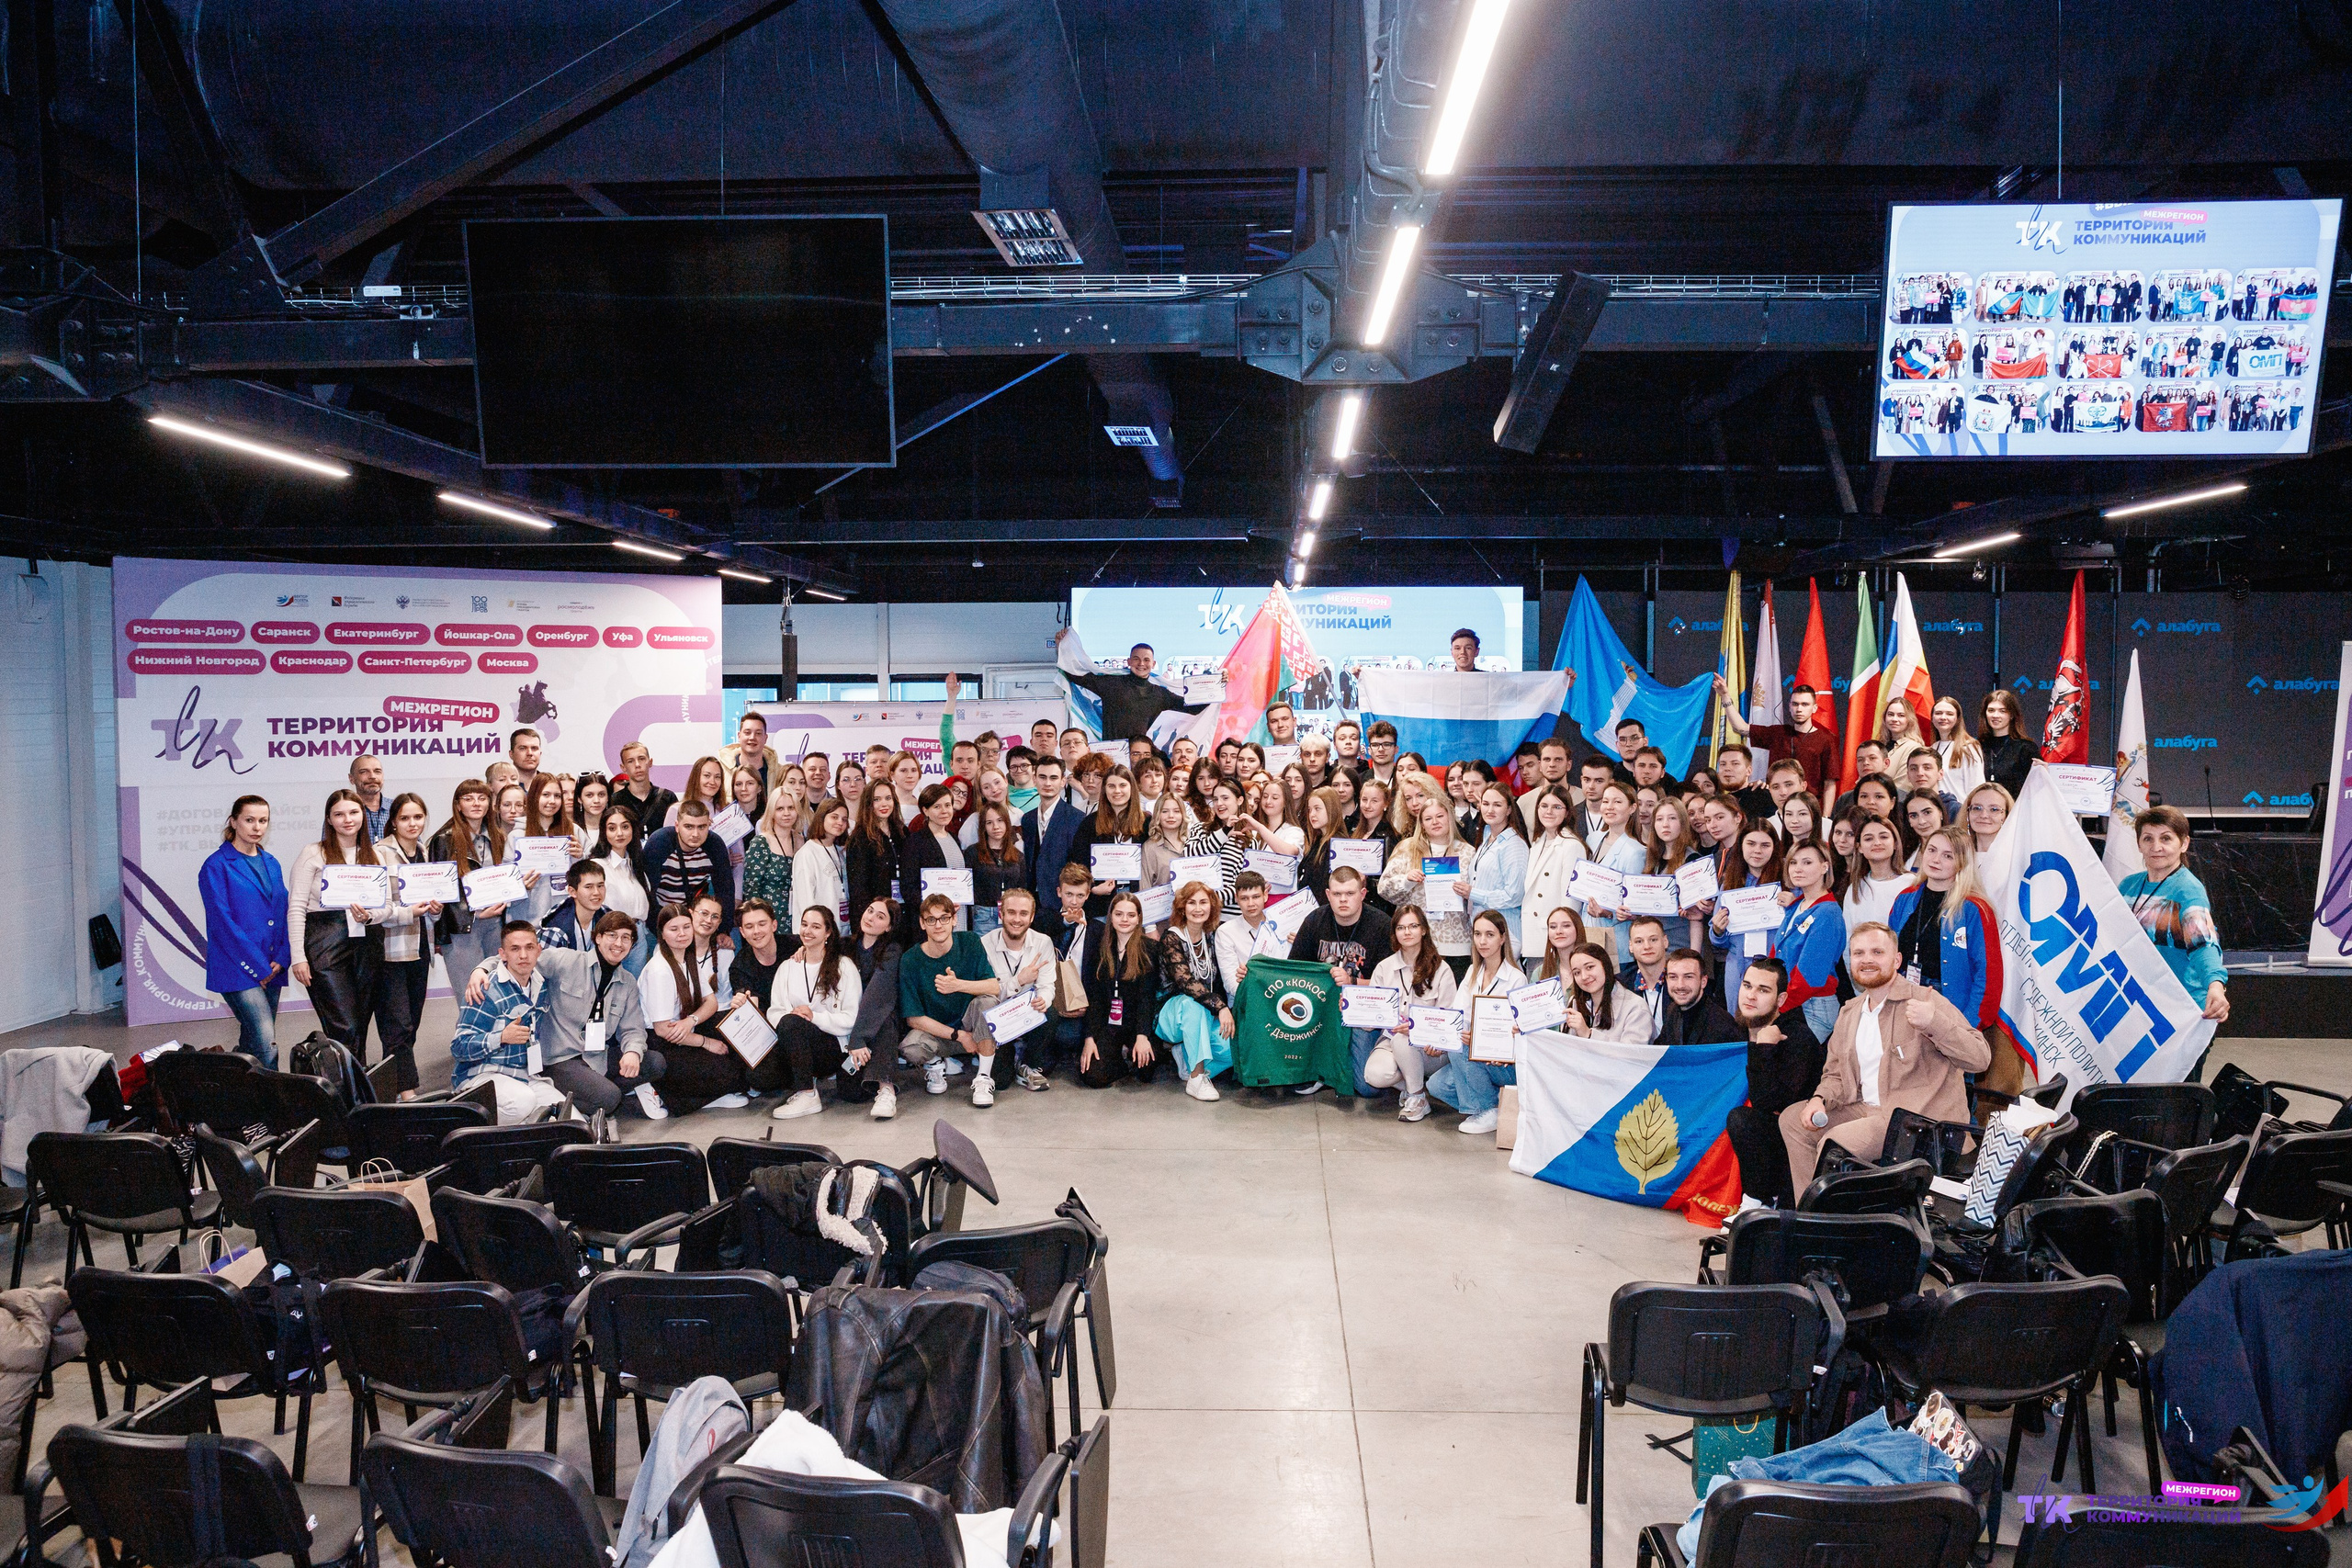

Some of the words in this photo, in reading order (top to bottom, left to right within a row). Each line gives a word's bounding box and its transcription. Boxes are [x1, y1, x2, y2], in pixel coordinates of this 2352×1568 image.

[2143, 209, 2204, 221] МЕЖРЕГИОН
[2075, 220, 2173, 231] ТЕРРИТОРИЯ
[2074, 230, 2206, 245] КОММУНИКАЦИЙ
[1326, 595, 1387, 605] МЕЖРЕГИОН
[133, 626, 240, 637] Ростов-на-Дону
[257, 627, 311, 637] Саранск
[1923, 620, 1984, 635] алабуга
[2156, 621, 2222, 635] алабуга
[334, 629, 419, 639] Екатеринбург
[444, 629, 515, 641] Йошкар-Ола
[535, 631, 590, 642] Оренбург
[612, 632, 634, 643] Уфа
[653, 633, 708, 643] Ульяновск
[135, 656, 192, 665] Нижний
[196, 656, 260, 667] Новгород
[278, 657, 347, 667] Краснодар
[364, 657, 467, 668] Санкт-Петербург
[486, 659, 529, 668] Москва
[2273, 679, 2339, 693] алабуга
[390, 699, 494, 719] МЕЖРЕГИОН
[266, 716, 443, 735] ТЕРРИТОРИЯ
[267, 732, 501, 758] КОММУНИКАЦИЙ
[2154, 736, 2218, 750] алабуга
[710, 813, 734, 831] ЕРТИФИКАТ
[1735, 895, 1769, 905] СЕРТИФИКАТ
[1264, 979, 1284, 998] СПО
[1270, 1021, 1323, 1043] Дзержинск
